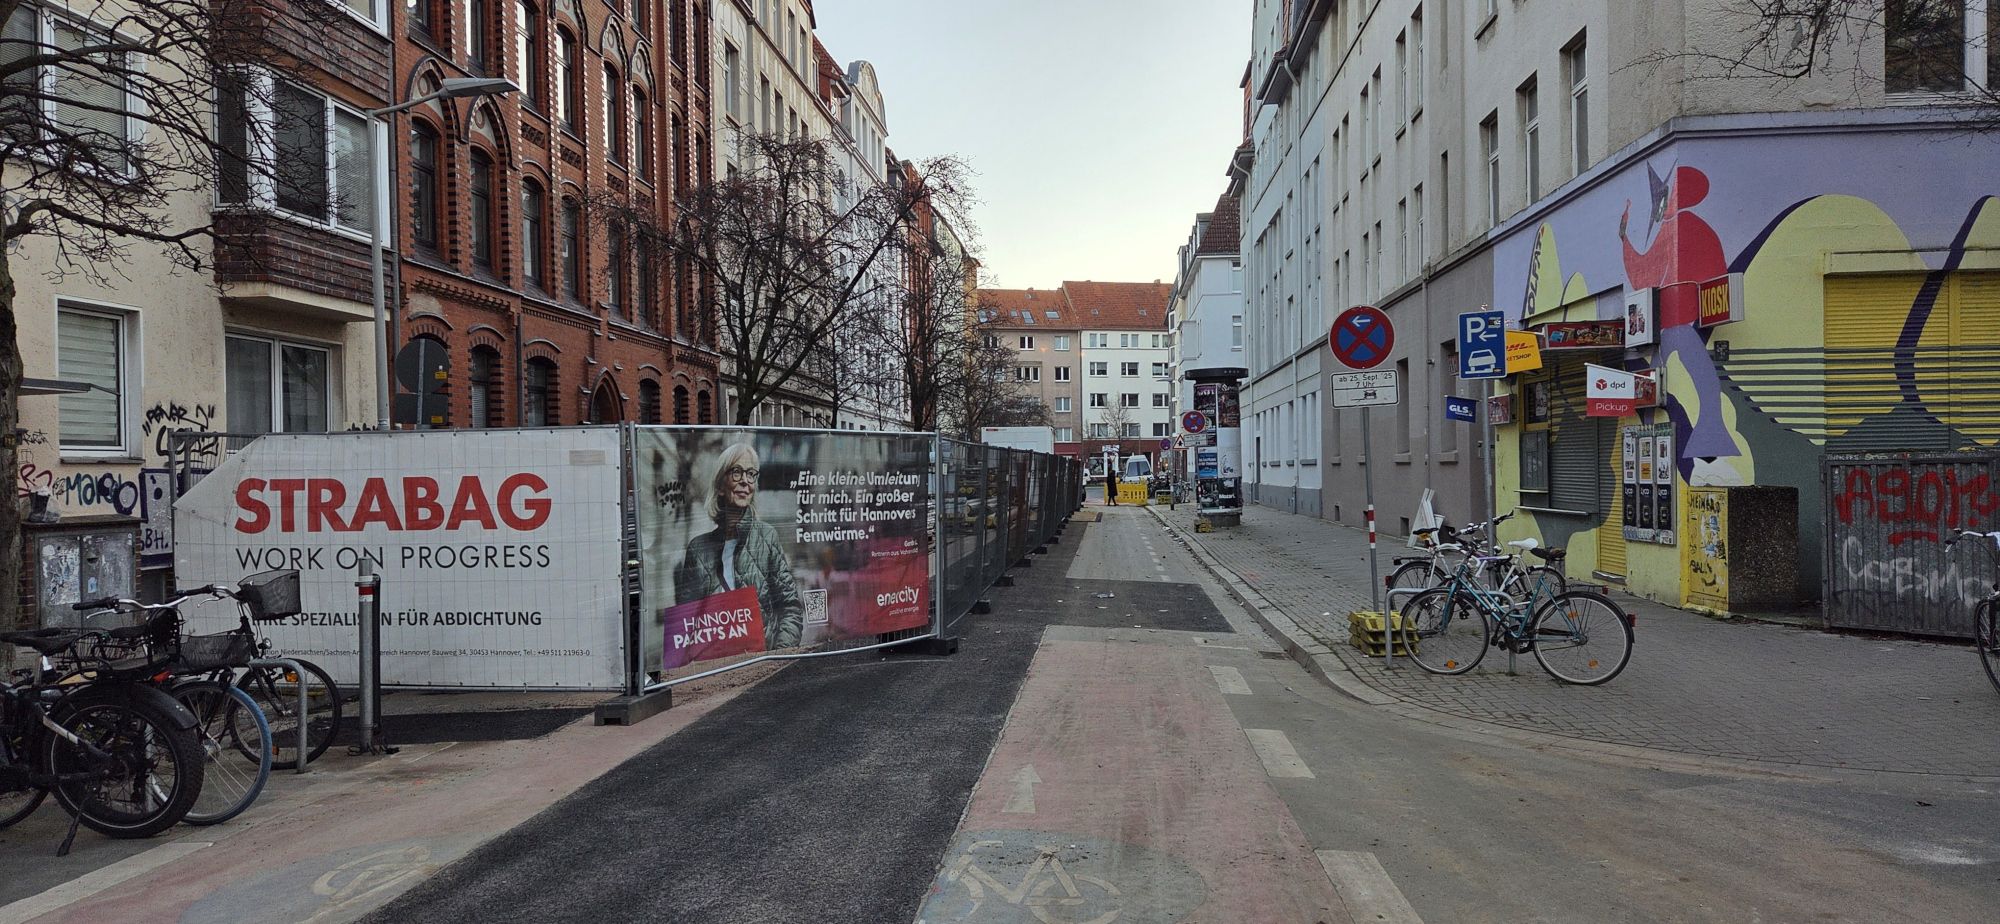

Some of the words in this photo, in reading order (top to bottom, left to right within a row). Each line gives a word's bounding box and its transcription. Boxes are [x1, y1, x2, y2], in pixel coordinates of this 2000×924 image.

[1701, 283, 1729, 318] KIOSK
[1466, 317, 1486, 343] P
[1610, 381, 1626, 390] dpd
[1449, 404, 1469, 414] GLS
[1595, 402, 1628, 412] Pickup
[828, 470, 866, 486] kleine
[235, 472, 552, 534] STRABAG
[796, 489, 816, 505] für
[818, 489, 853, 504] mich.
[855, 489, 873, 504] Ein
[875, 488, 914, 506] großer
[796, 507, 837, 524] Schritt
[839, 507, 857, 522] für
[236, 547, 324, 570] WORK
[336, 546, 384, 570] ON
[401, 545, 550, 569] PROGRESS
[877, 585, 919, 607] enercity
[291, 612, 392, 626] SPEZIALIN
[398, 609, 429, 626] FÜR
[433, 611, 542, 626] ABDICHTUNG
[729, 623, 748, 639] AN
[281, 648, 360, 657] Niedersachsen/Sachsen-An
[400, 648, 431, 657] Hannover,
[432, 648, 457, 657] Bauweg
[469, 648, 489, 656] 30453
[490, 648, 522, 657] Hannover,
[537, 648, 550, 656] +49
[550, 648, 561, 656] 511
[563, 648, 591, 657] 21963-0
